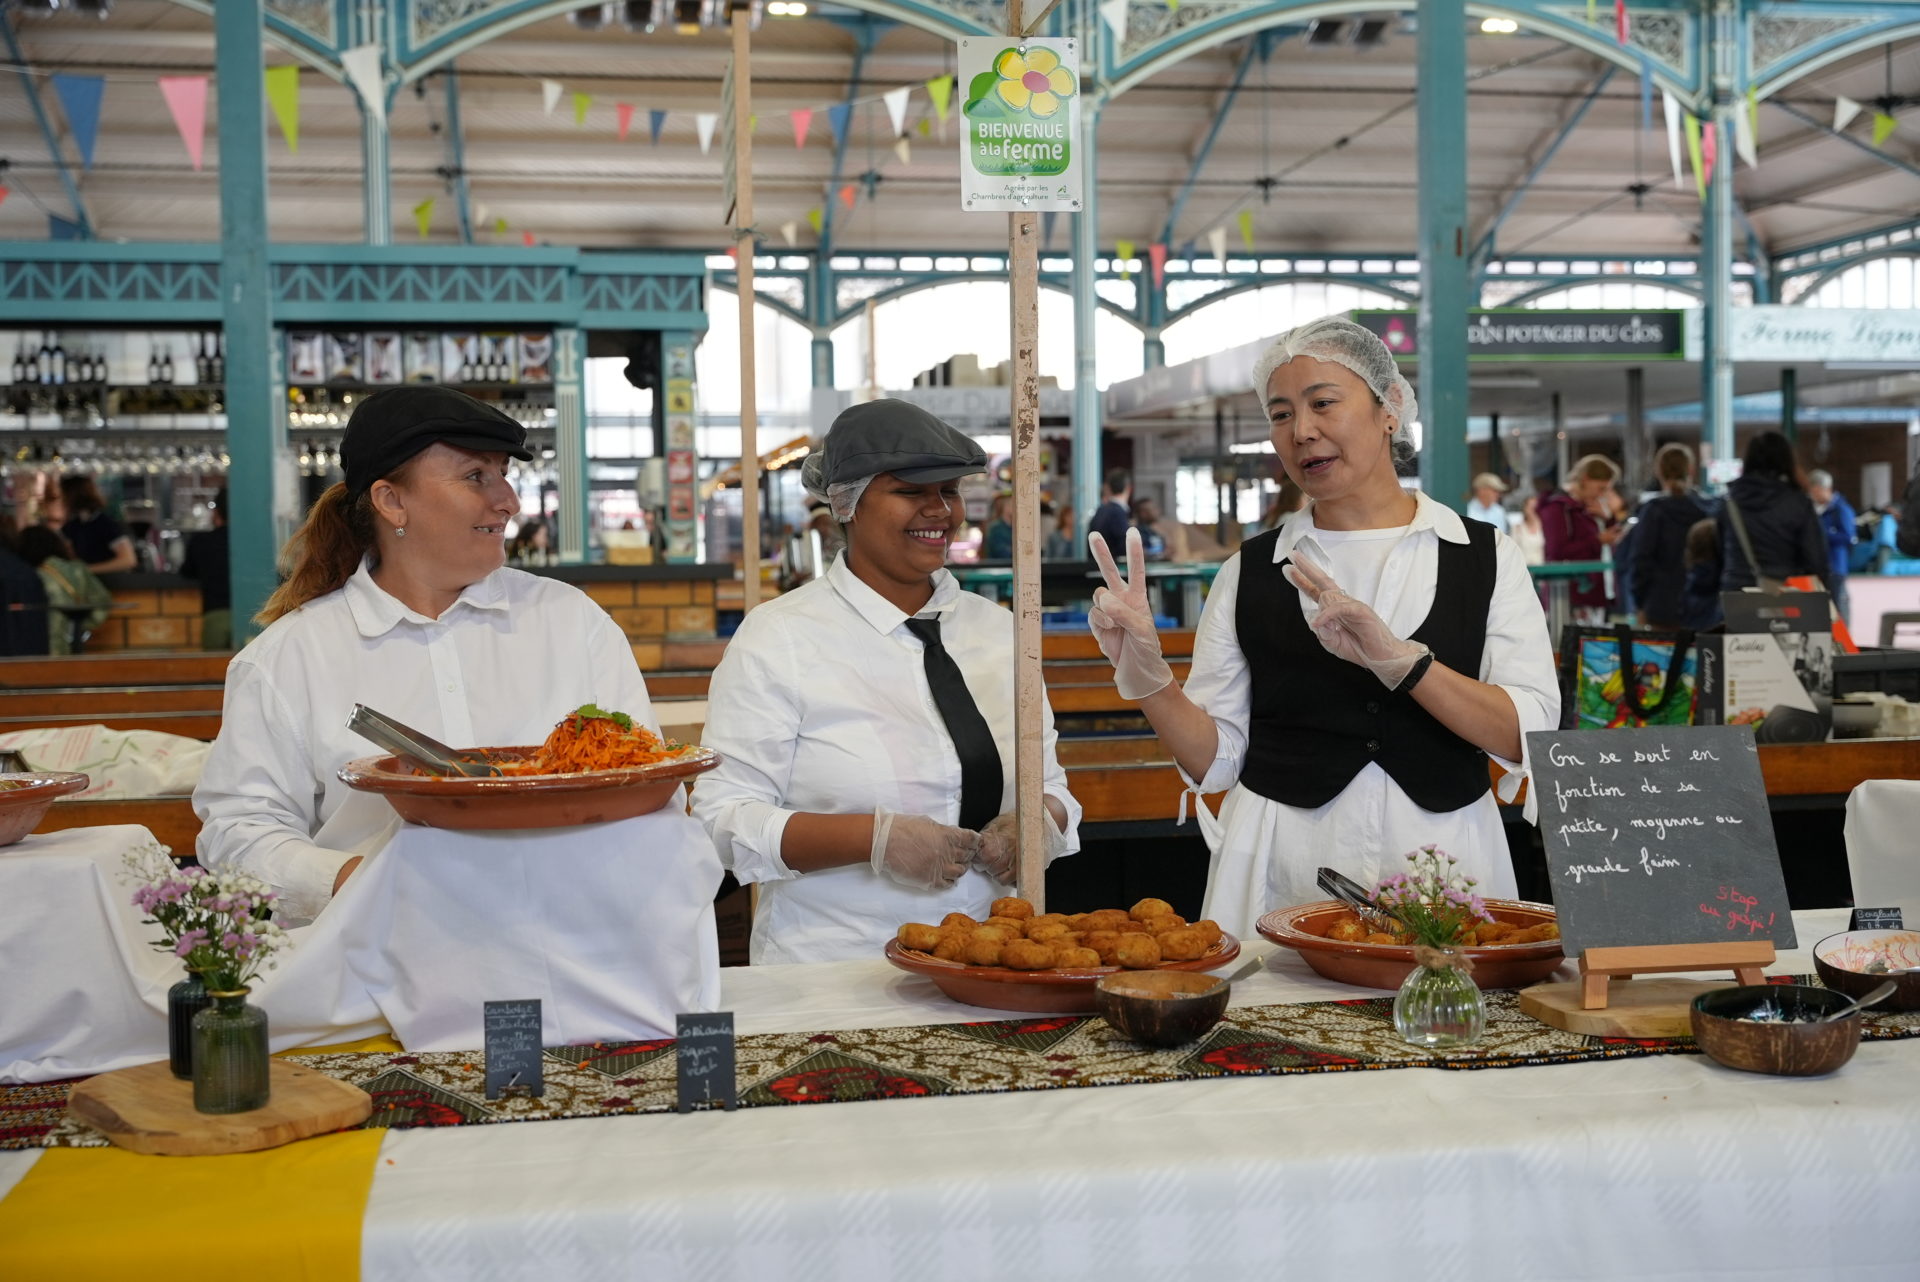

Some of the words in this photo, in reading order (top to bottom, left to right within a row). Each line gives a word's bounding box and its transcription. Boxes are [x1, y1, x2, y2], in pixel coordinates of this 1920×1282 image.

[978, 122, 1063, 139] BIENVENUE
[980, 141, 987, 156] à
[989, 142, 1001, 156] la
[1003, 138, 1063, 160] ferme
[971, 192, 1006, 200] Chambres
[1007, 193, 1049, 202] d'agrculture
[1003, 184, 1025, 193] Agrée
[1505, 324, 1587, 343] POTAGER
[1588, 324, 1619, 343] DU
[1741, 314, 1835, 345] Ferme
[1550, 743, 1586, 767] On
[1599, 752, 1622, 763] se
[1633, 744, 1672, 763] sert
[1689, 749, 1720, 761] en
[1555, 776, 1626, 813] fonction
[1641, 777, 1661, 794] de
[1677, 781, 1701, 792] sa
[1558, 818, 1618, 847] petite,
[1630, 816, 1705, 840] moyenne
[1715, 815, 1743, 825] ou
[1564, 857, 1630, 884] grande
[1699, 903, 1722, 917] au
[1716, 886, 1759, 913] Stop
